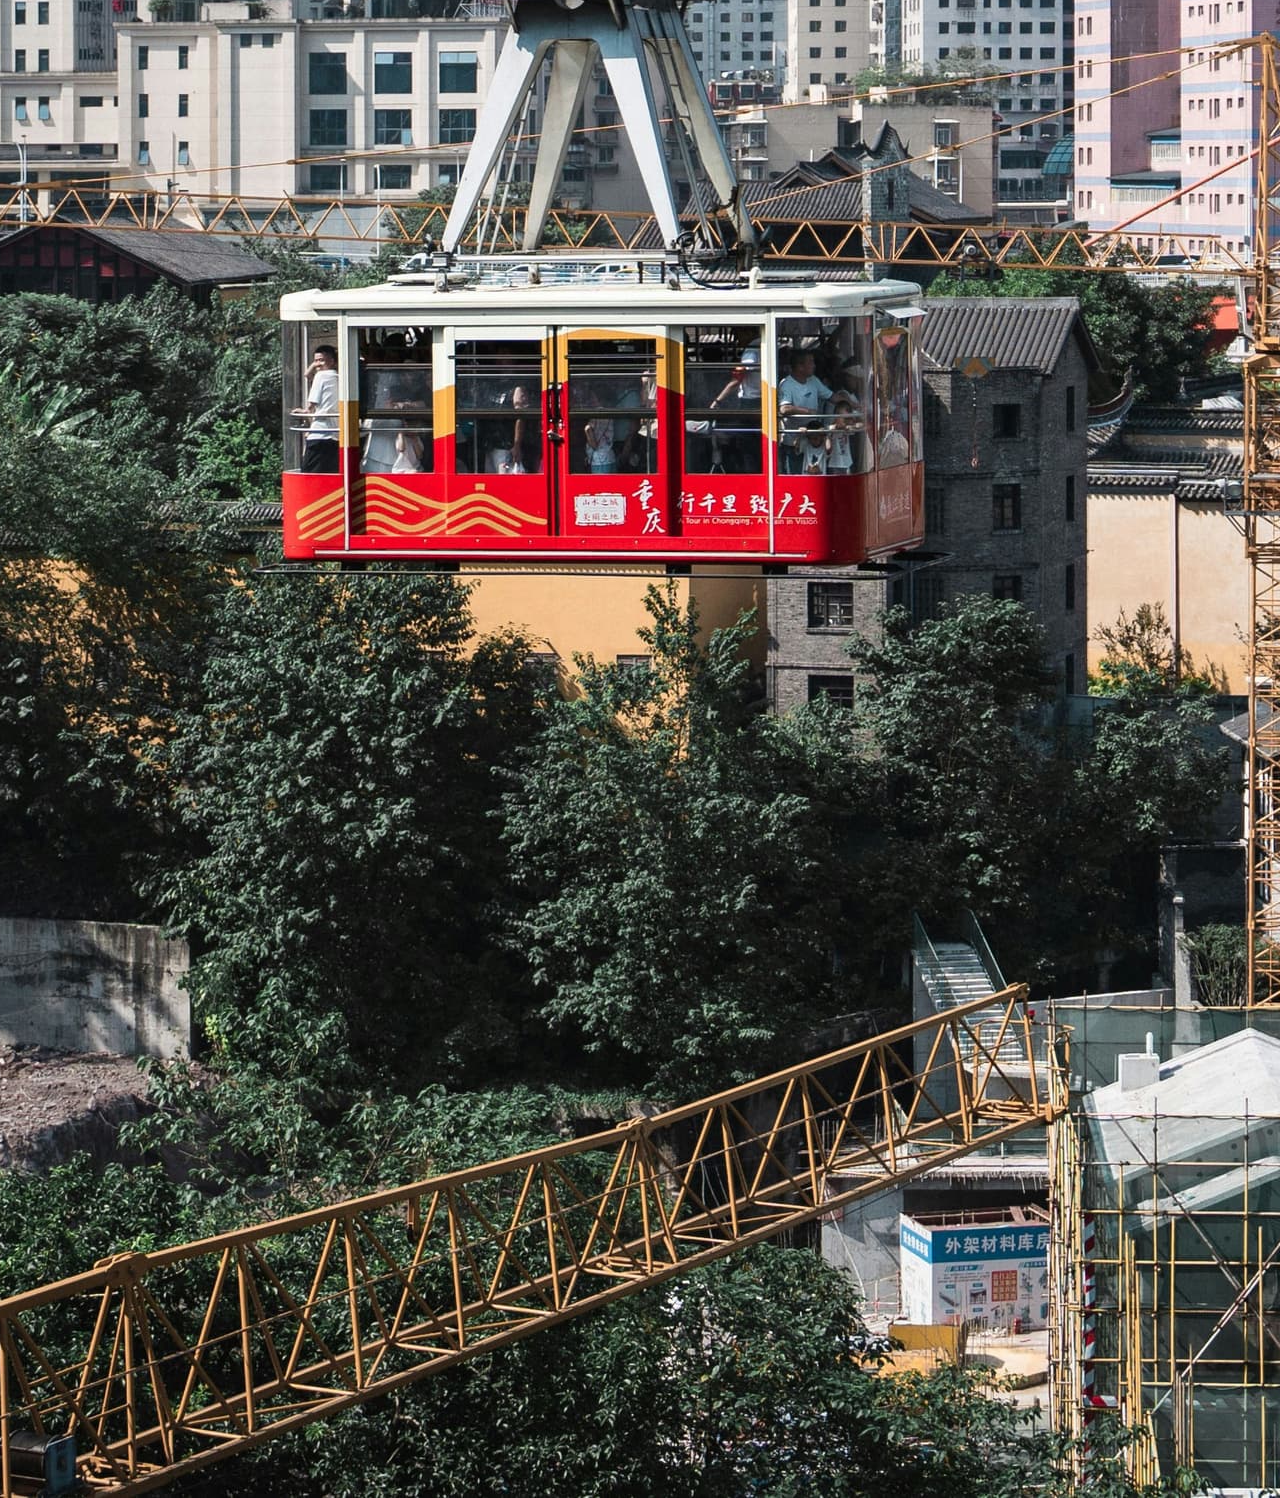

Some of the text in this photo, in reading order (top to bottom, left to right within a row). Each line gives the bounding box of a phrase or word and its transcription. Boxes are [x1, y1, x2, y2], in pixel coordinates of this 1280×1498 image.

[631, 479, 666, 535] 重庆
[677, 491, 817, 519] 行千里 致广大
[945, 1233, 1050, 1254] 外架材料库房
